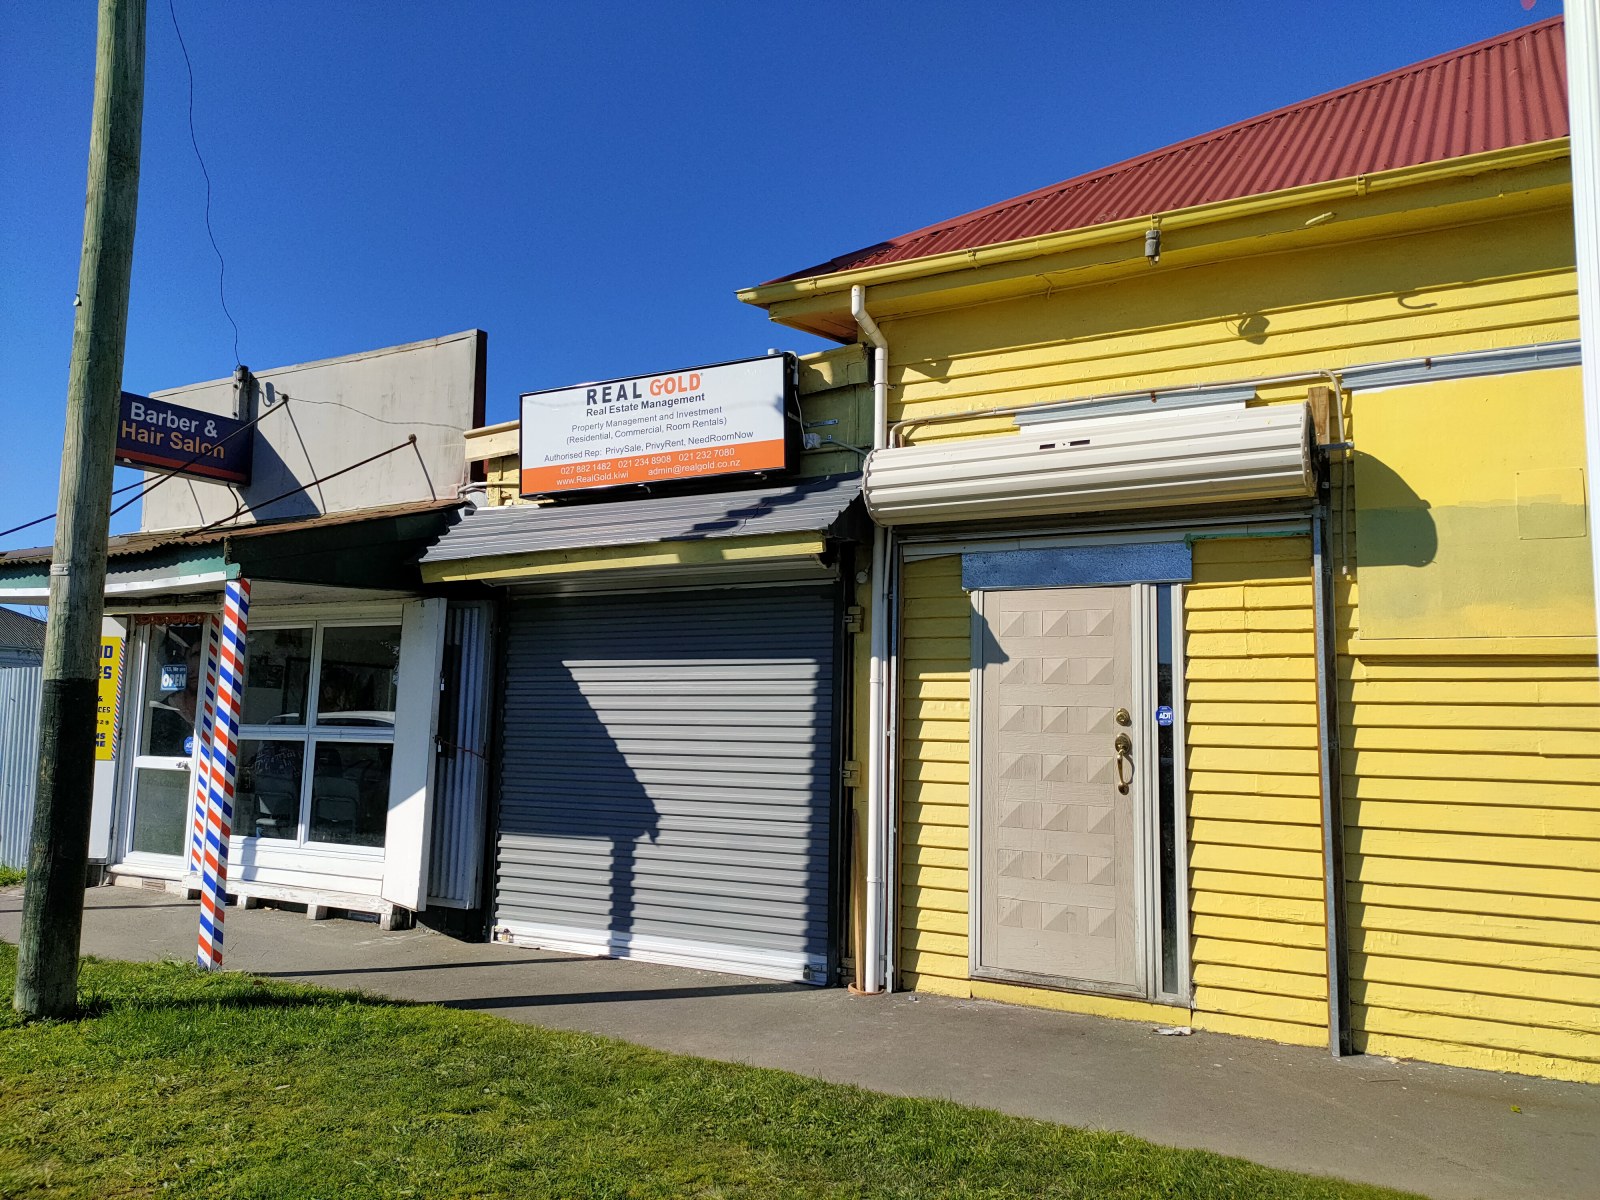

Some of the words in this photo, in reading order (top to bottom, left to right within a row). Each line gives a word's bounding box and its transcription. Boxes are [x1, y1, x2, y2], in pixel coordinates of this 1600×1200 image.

[586, 382, 642, 406] REAL
[649, 373, 701, 397] GOLD
[586, 407, 607, 417] Real
[609, 403, 639, 414] Estate
[640, 393, 705, 409] Management
[130, 401, 199, 433] Barber
[204, 419, 218, 438] &
[566, 431, 613, 445] (Residential,
[614, 425, 664, 438] Commercial,
[666, 422, 691, 432] Room
[692, 417, 728, 428] Rentals)
[571, 422, 604, 433] Property
[605, 414, 657, 428] Management
[659, 412, 674, 421] and
[676, 406, 723, 418] Investment
[121, 420, 165, 446] Hair
[169, 431, 225, 459] Salon
[544, 450, 583, 462] Authorised
[584, 449, 602, 458] Rep:
[605, 444, 643, 455] PrivySale,
[645, 439, 686, 450] PrivyRent,
[688, 430, 754, 444] NeedRoomNow
[556, 470, 629, 486] www.RealGold.kiwi
[648, 459, 741, 476] admin@realgold.co.nz
[560, 466, 575, 475] 027
[617, 459, 632, 468] 021
[634, 457, 649, 467] 234
[678, 452, 694, 461] 021
[695, 450, 712, 460] 232
[162, 673, 186, 688] OPEN
[1159, 712, 1172, 720] ADT
